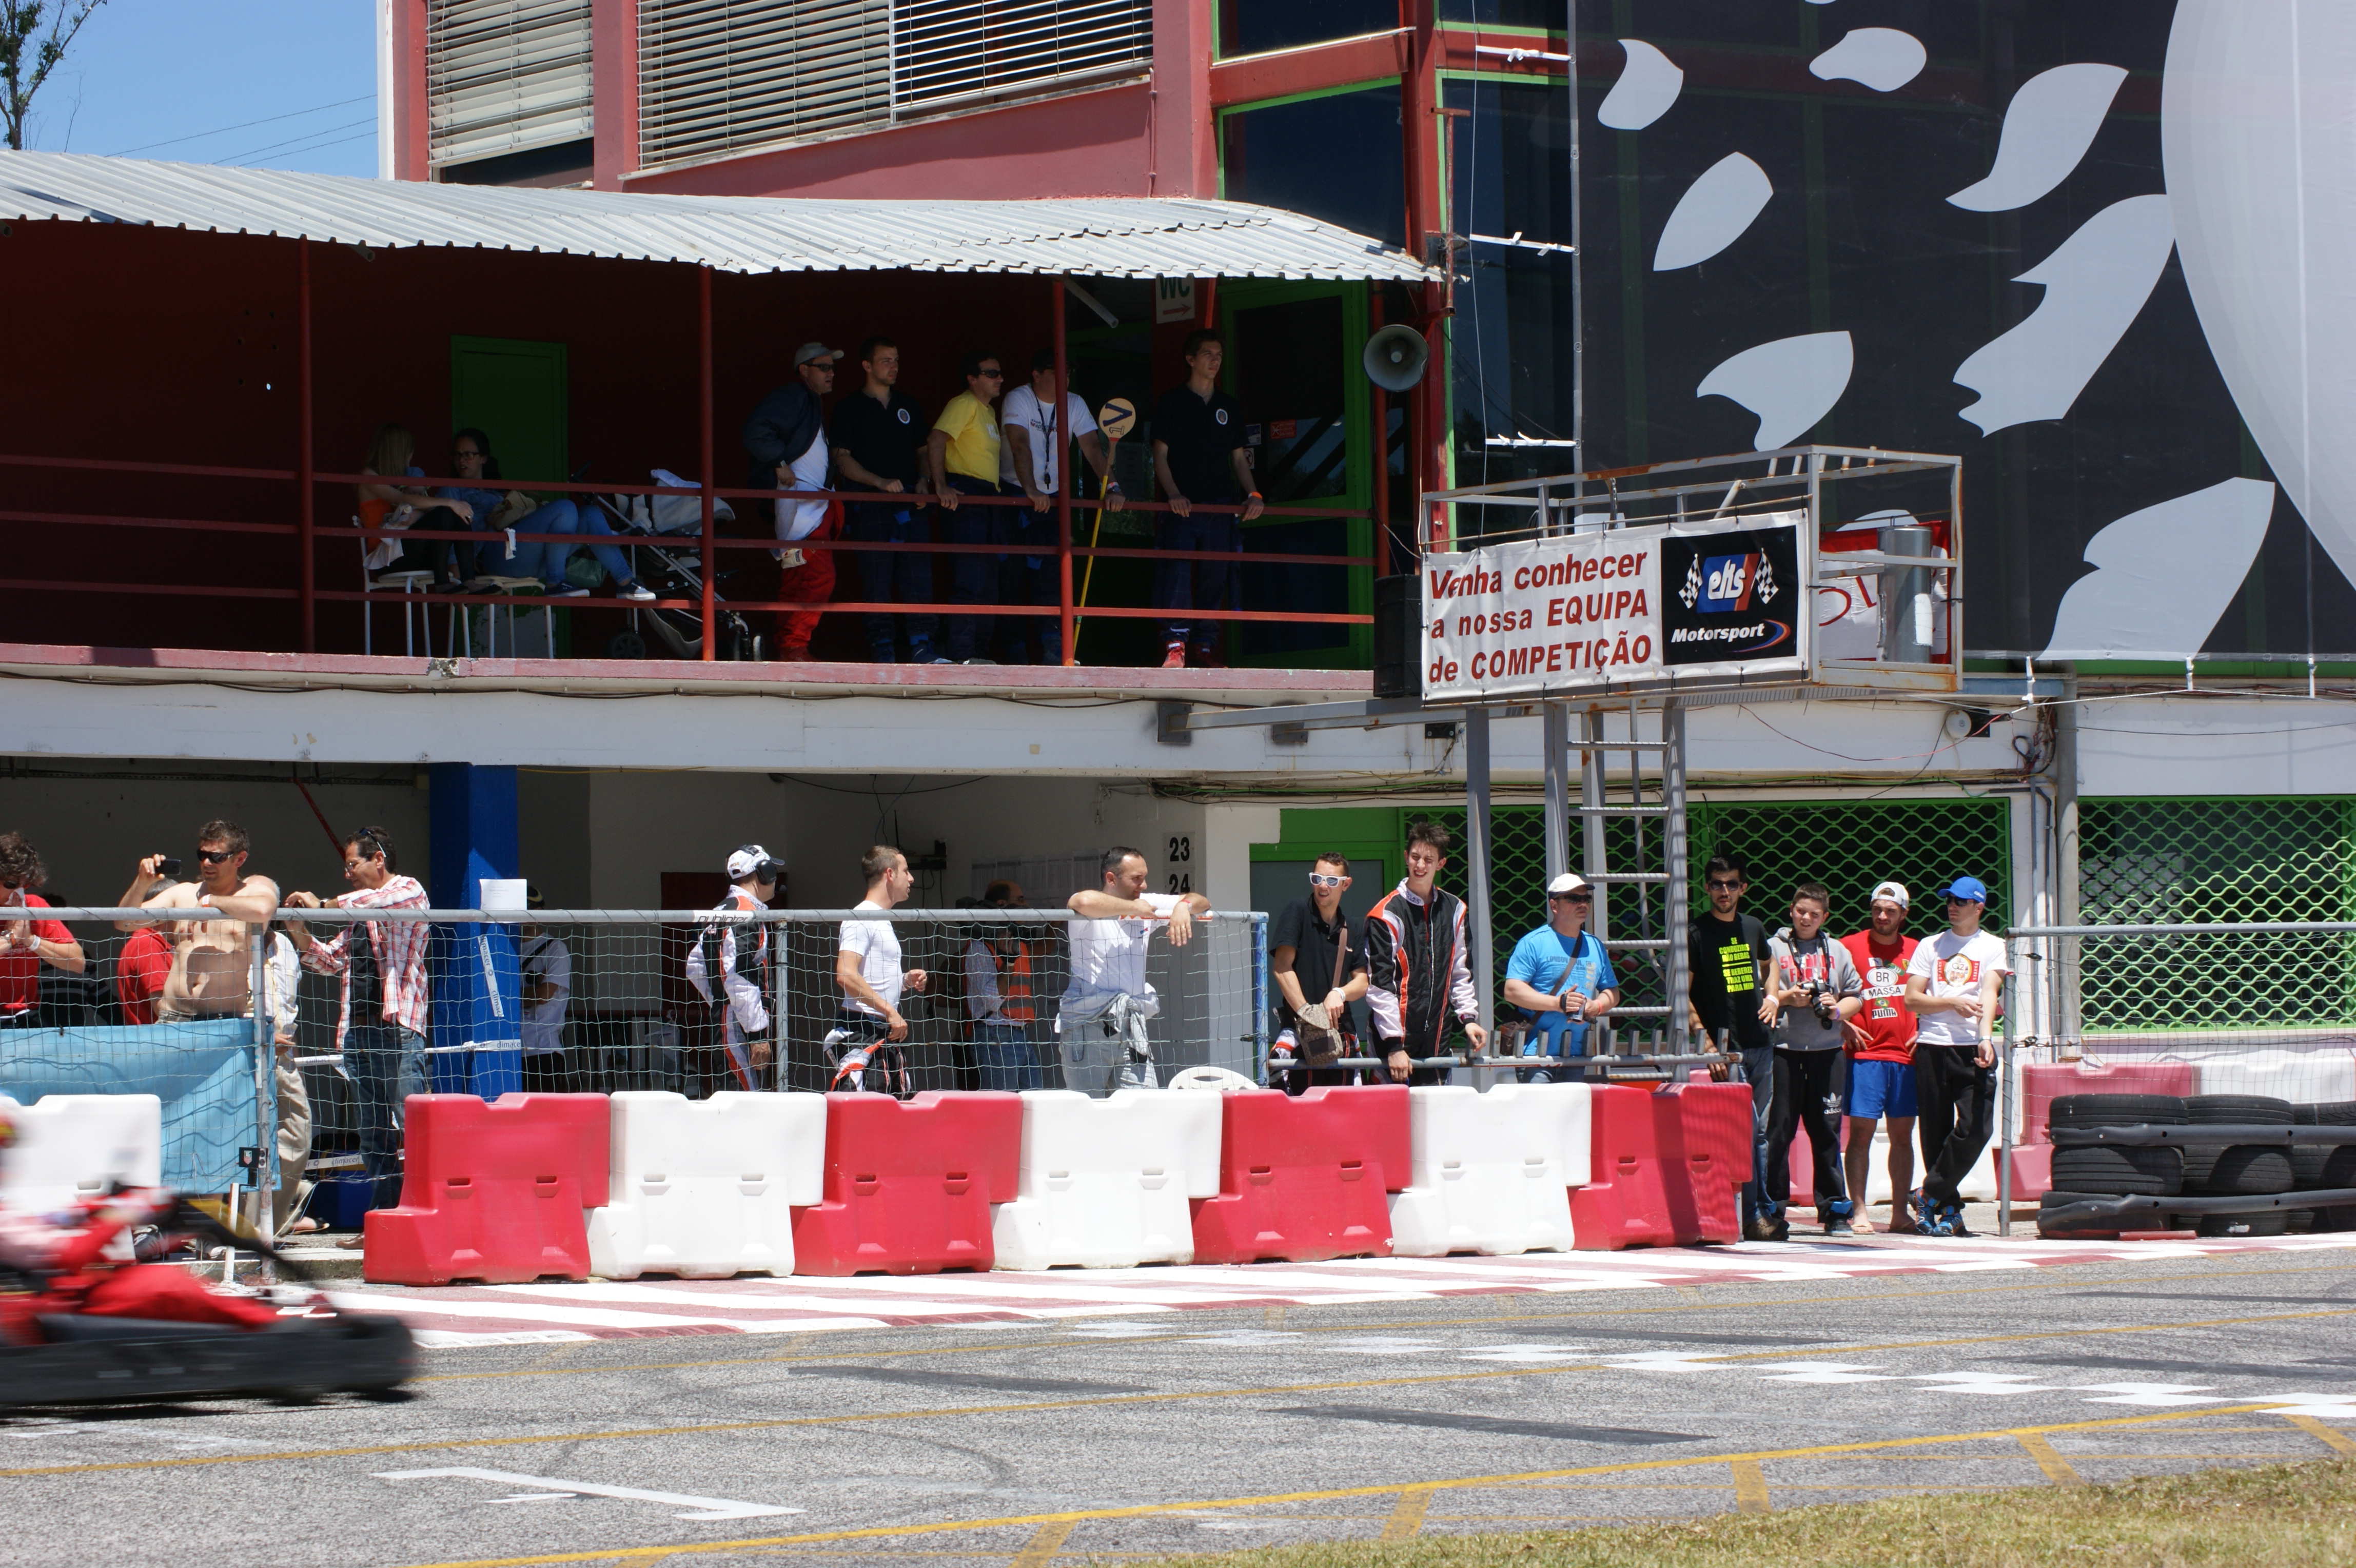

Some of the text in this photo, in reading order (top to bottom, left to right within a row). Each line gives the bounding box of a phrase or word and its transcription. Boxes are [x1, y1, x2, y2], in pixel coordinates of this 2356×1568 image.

[1160, 277, 1190, 300] WC
[1428, 551, 1648, 599] Venha conhecer
[1431, 589, 1648, 639] a nossa EQUIPA
[1671, 622, 1765, 643] Motorsport
[1428, 630, 1652, 683] de COMPETIÇÃO
[1169, 836, 1190, 862] 23
[1169, 873, 1190, 895] 24
[1726, 976, 1741, 984] TRAZ
[1876, 971, 1890, 983] BR
[1727, 984, 1743, 993] PARA
[1869, 986, 1901, 997] MASSA
[1872, 1008, 1897, 1019] PUMA
[331, 1156, 359, 1165] climacer
